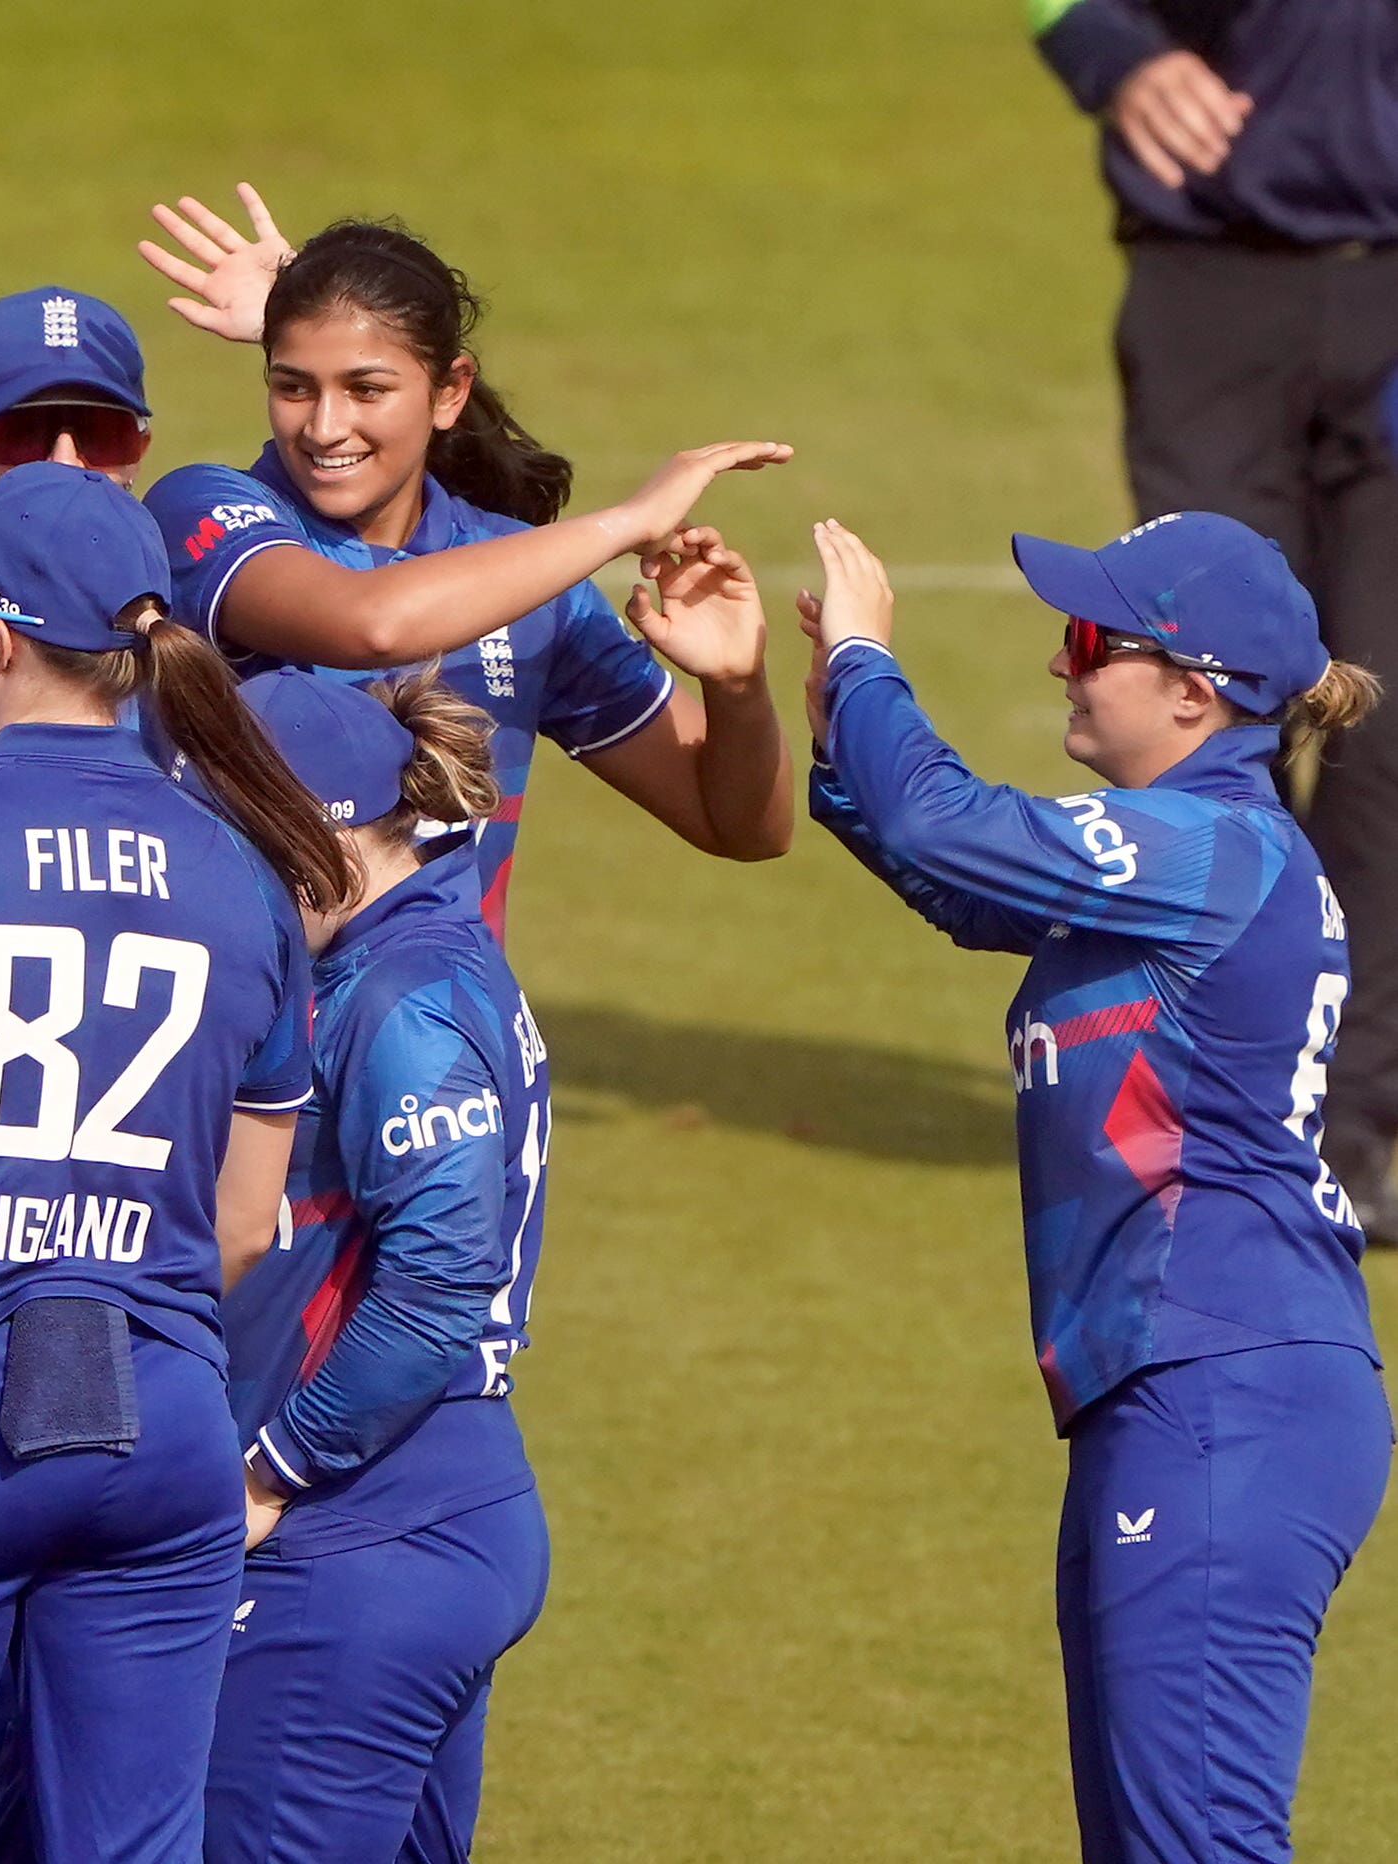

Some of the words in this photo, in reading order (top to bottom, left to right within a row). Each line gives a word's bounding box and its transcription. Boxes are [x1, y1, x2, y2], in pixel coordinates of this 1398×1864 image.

[322, 799, 355, 822] 09
[25, 828, 170, 900] FILER
[382, 1088, 504, 1156] cinch
